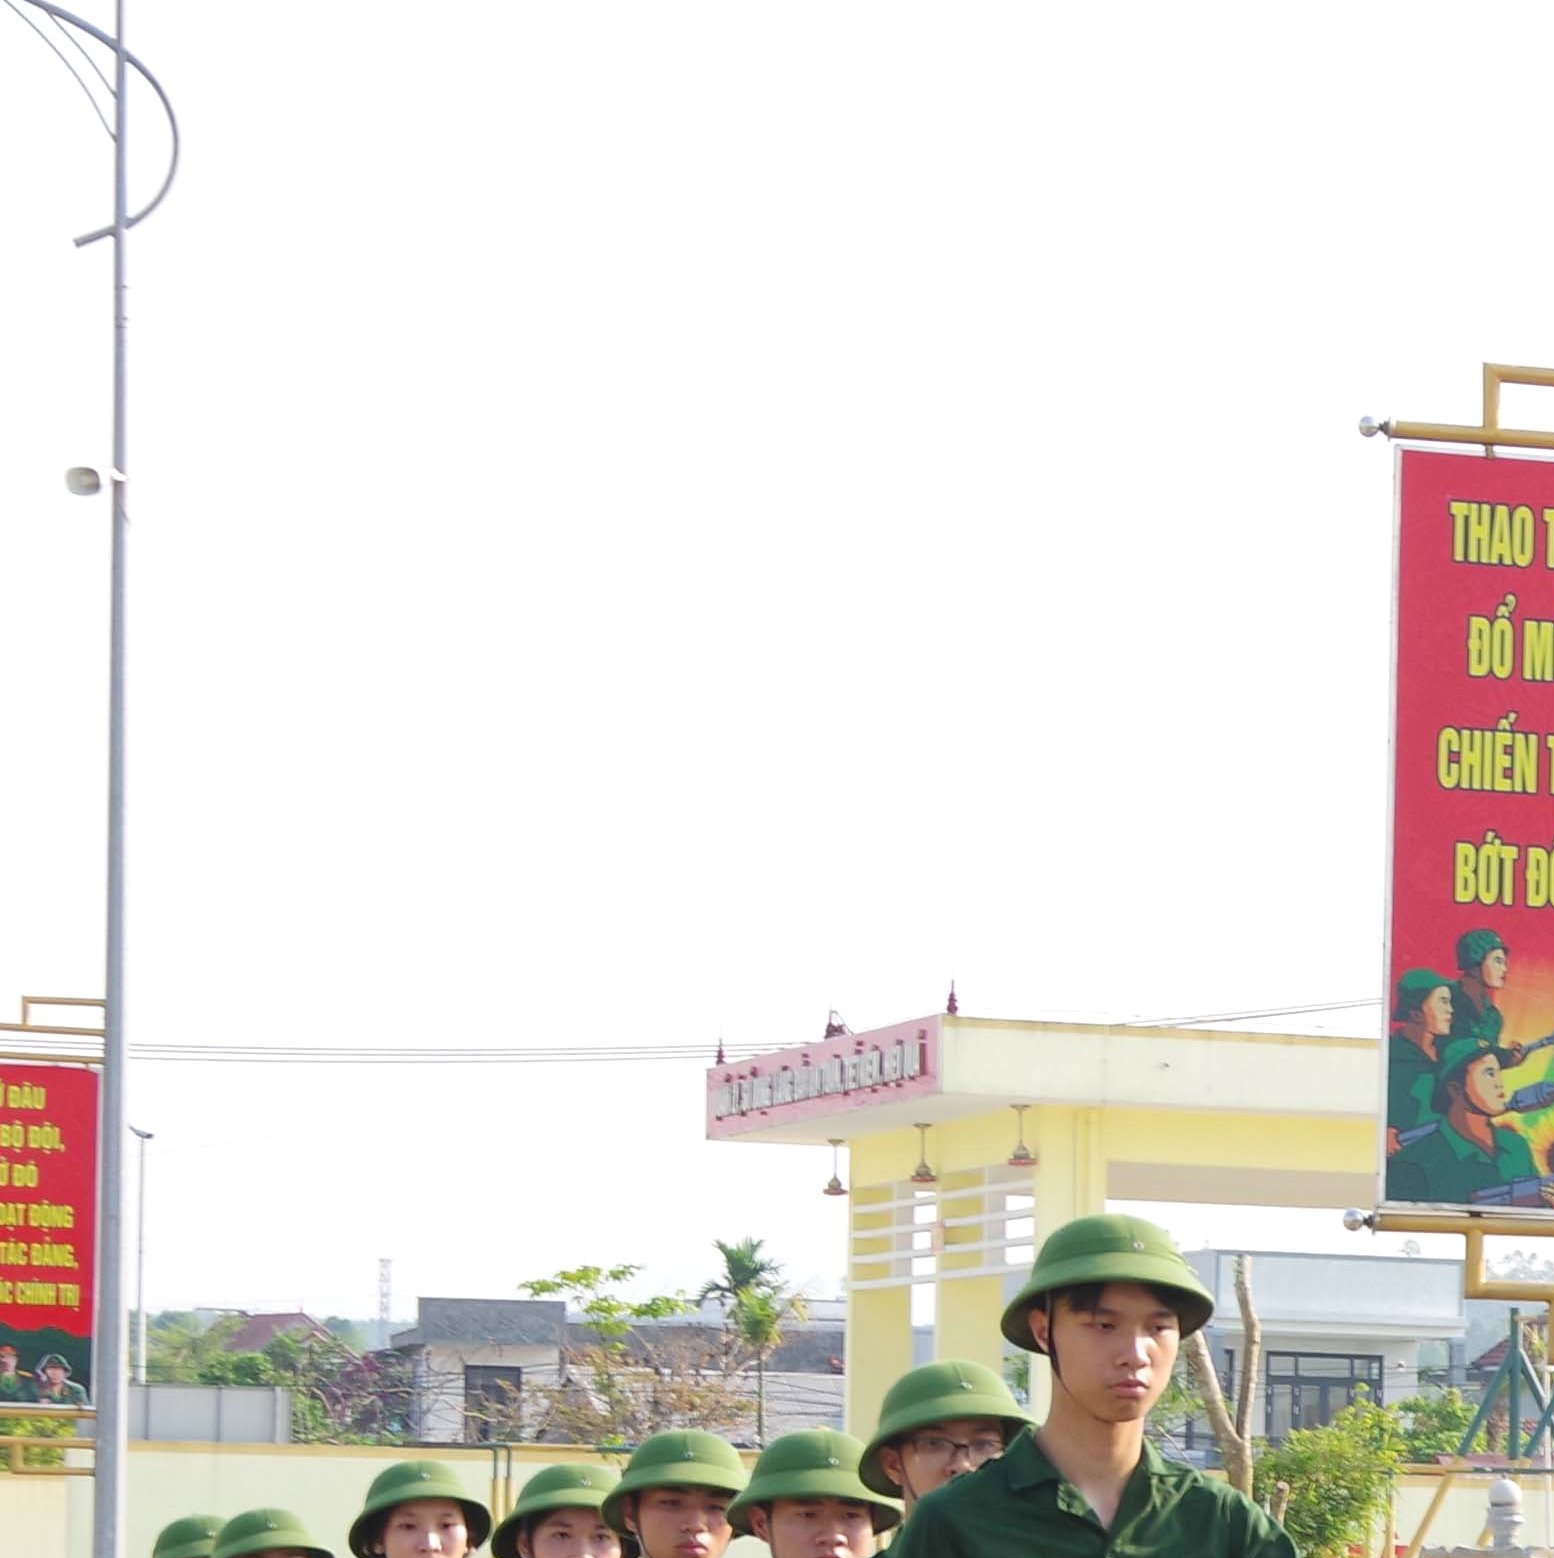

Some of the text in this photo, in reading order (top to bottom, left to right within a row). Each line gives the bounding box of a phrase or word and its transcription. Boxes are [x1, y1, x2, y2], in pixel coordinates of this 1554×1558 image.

[1449, 499, 1534, 567] THAO
[1467, 593, 1517, 679] ĐỔ
[1437, 712, 1538, 794] CHIẾN
[1454, 831, 1519, 905] BỚT
